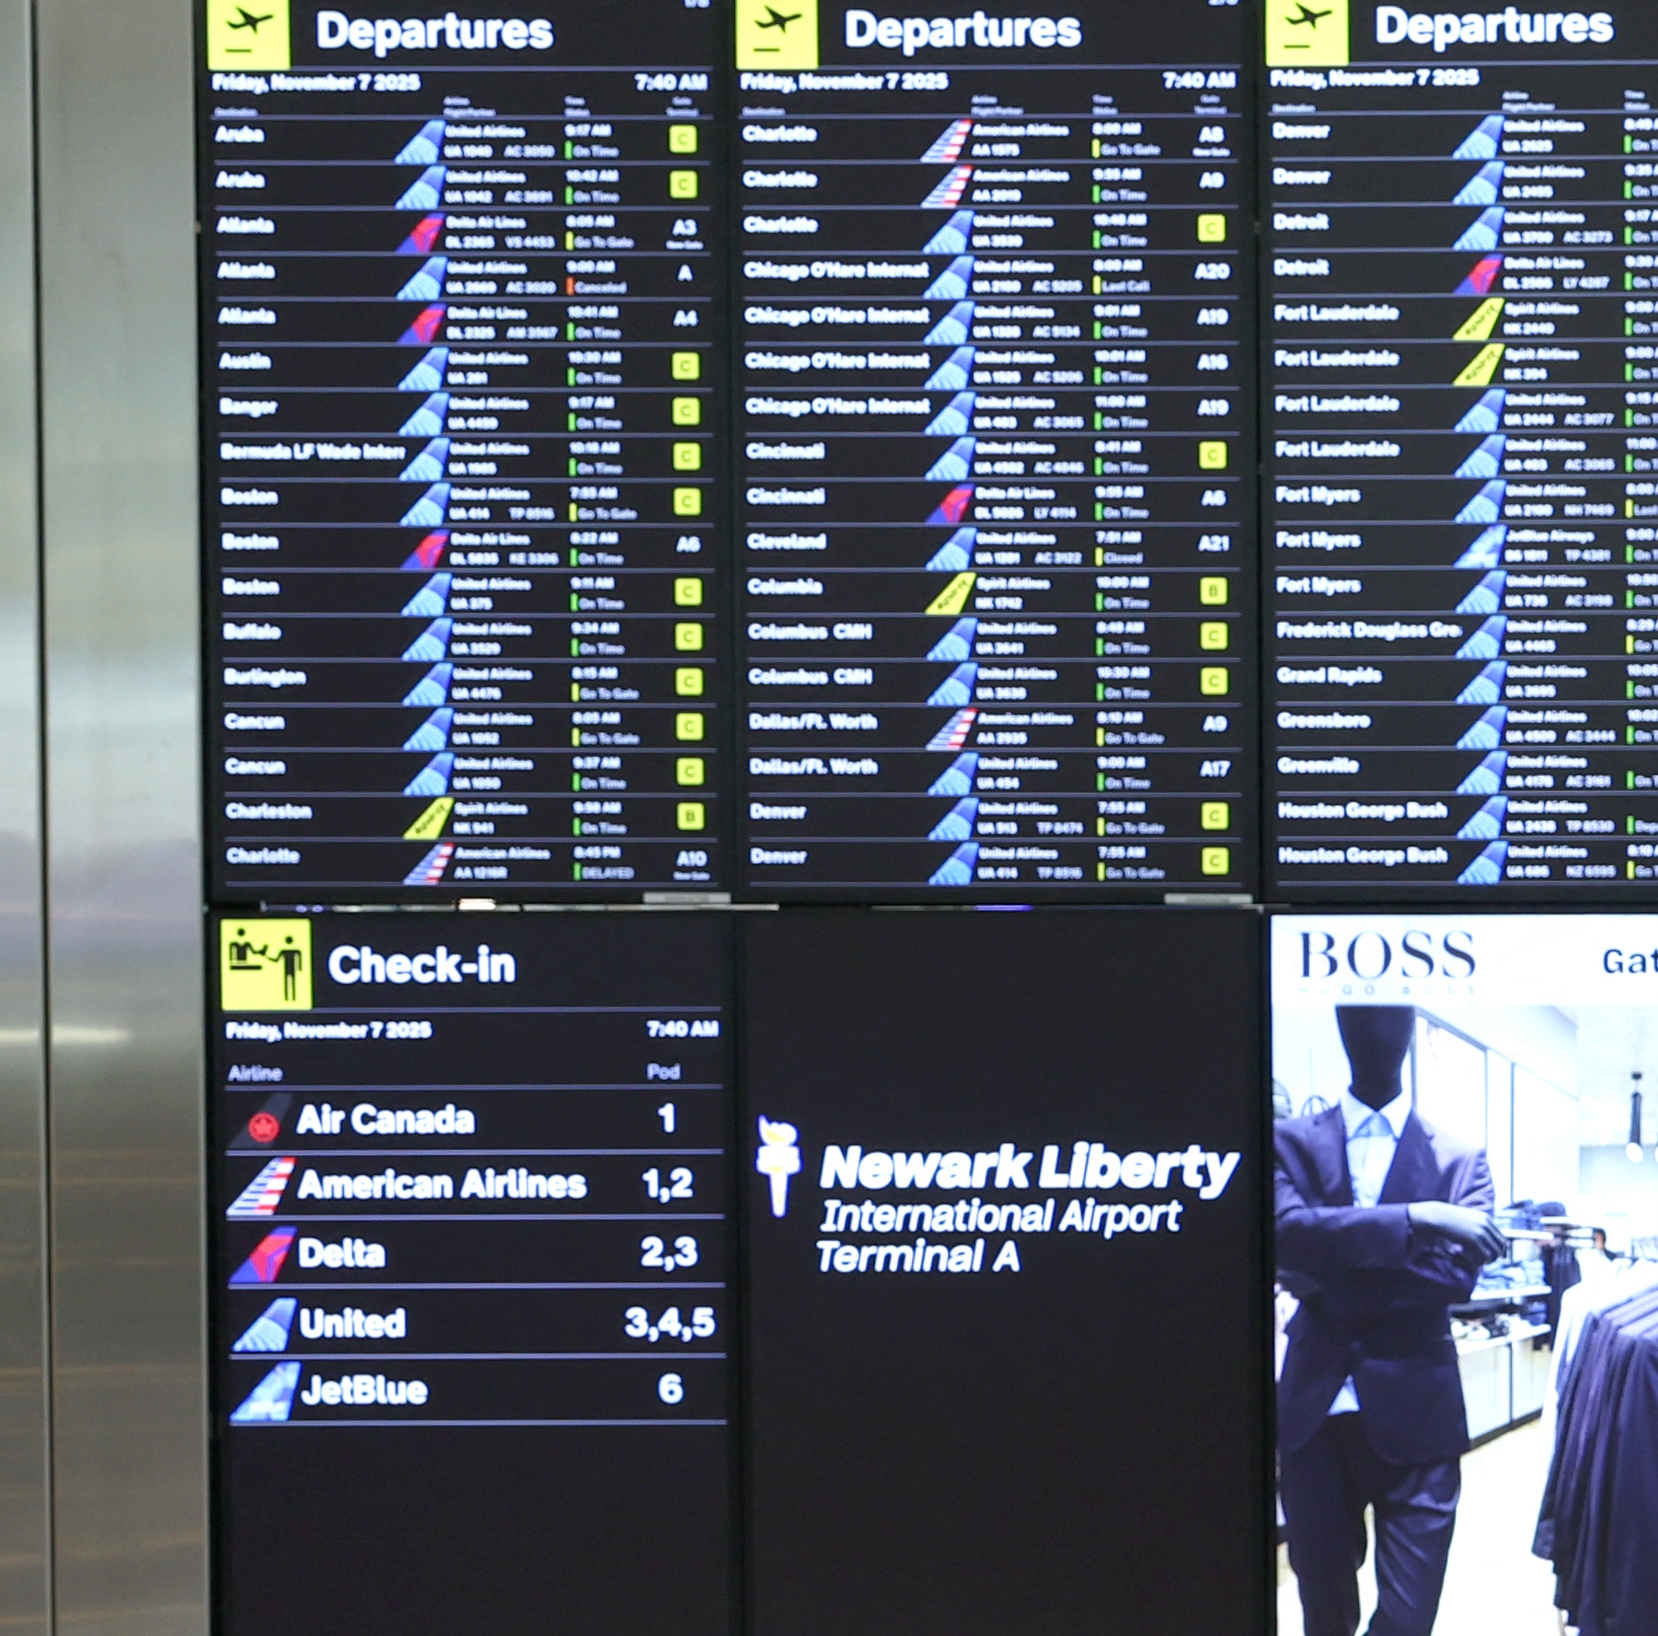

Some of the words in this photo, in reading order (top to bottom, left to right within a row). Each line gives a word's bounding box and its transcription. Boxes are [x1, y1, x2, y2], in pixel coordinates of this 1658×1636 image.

[318, 11, 553, 57] Departures
[846, 10, 1081, 56] Departures
[1377, 6, 1613, 52] Departures
[212, 73, 269, 94] Friday,
[271, 74, 356, 91] November
[358, 74, 371, 90] 7
[374, 74, 420, 91] 2025
[635, 74, 677, 90] 7:40
[679, 74, 707, 90] AM
[741, 73, 797, 93] Friday,
[799, 73, 884, 90] November
[886, 73, 899, 89] 7
[902, 72, 948, 89] 2025
[1163, 72, 1205, 88] 7:40
[1206, 72, 1236, 88] AM
[1270, 69, 1327, 90] Friday,
[1329, 69, 1415, 86] November
[1416, 69, 1430, 86] 7
[1432, 68, 1479, 86] 2025
[215, 126, 264, 142] Aruba
[445, 125, 482, 138] United
[483, 125, 526, 138] Airlines
[217, 217, 274, 233] Atlanta
[673, 219, 697, 235] A3
[1274, 213, 1329, 230] Detroit
[1195, 263, 1230, 279] A20
[221, 488, 278, 504] Boston
[1276, 486, 1310, 502] Fort
[1311, 486, 1361, 505] Myers
[223, 623, 281, 639] Buffalo
[748, 624, 828, 639] Columbus
[833, 623, 872, 639] CMH
[225, 713, 285, 729] Cancun
[750, 803, 806, 819] Denver
[677, 851, 707, 866] A10
[329, 945, 515, 983] Check-in
[1301, 932, 1475, 978] BOSS
[226, 1022, 282, 1042] Friday,
[284, 1022, 368, 1038] November
[370, 1021, 383, 1038] 7
[386, 1021, 432, 1038] 2025
[647, 1021, 688, 1037] 7:40
[690, 1021, 719, 1036] AM
[228, 1065, 282, 1081] Airline
[647, 1064, 680, 1079] Pod
[297, 1104, 345, 1134] Air
[351, 1104, 474, 1134] Canada
[658, 1103, 674, 1132] 1
[820, 1143, 1033, 1188] Newark
[1039, 1141, 1240, 1199] Liberty
[298, 1168, 453, 1199] American
[460, 1168, 587, 1198] Airlines
[643, 1168, 693, 1203] 1,2
[820, 1198, 1055, 1232] International
[1059, 1198, 1183, 1239] Airport
[299, 1238, 385, 1268] Delta
[641, 1236, 697, 1271] 2,3
[817, 1238, 984, 1272] Terminal
[993, 1241, 1019, 1272] A
[300, 1307, 405, 1338] United
[625, 1307, 715, 1342] 3,4,5
[301, 1375, 428, 1405] JetBlue
[659, 1374, 683, 1403] 6
